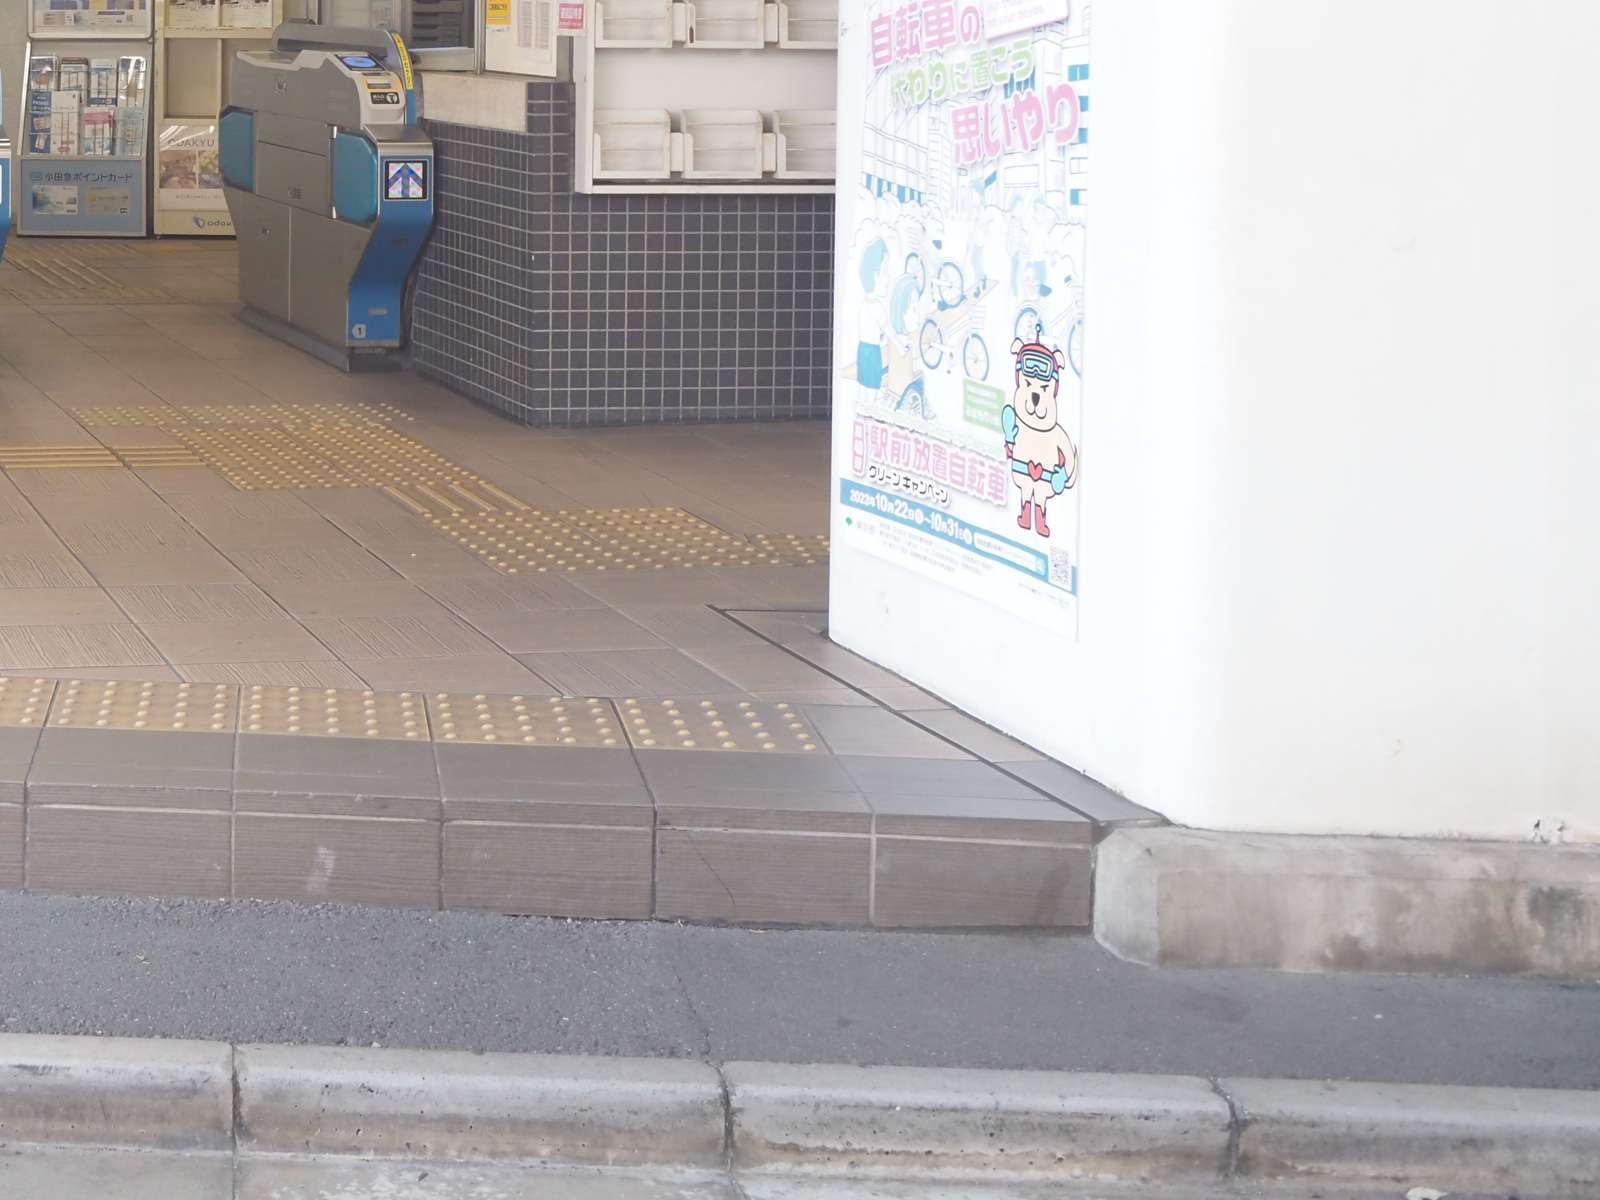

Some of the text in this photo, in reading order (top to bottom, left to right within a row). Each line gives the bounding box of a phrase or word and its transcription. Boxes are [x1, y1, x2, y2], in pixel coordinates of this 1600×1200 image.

[890, 39, 1035, 108] 代わりに置こう
[168, 138, 215, 147] ODAKYU
[952, 83, 1079, 164] 思いやり
[45, 171, 133, 183] 小田急ポイントカード
[357, 326, 362, 336] 1
[870, 424, 1007, 504] 駅前放置自転車
[869, 465, 948, 504] クリーンキャンペーン
